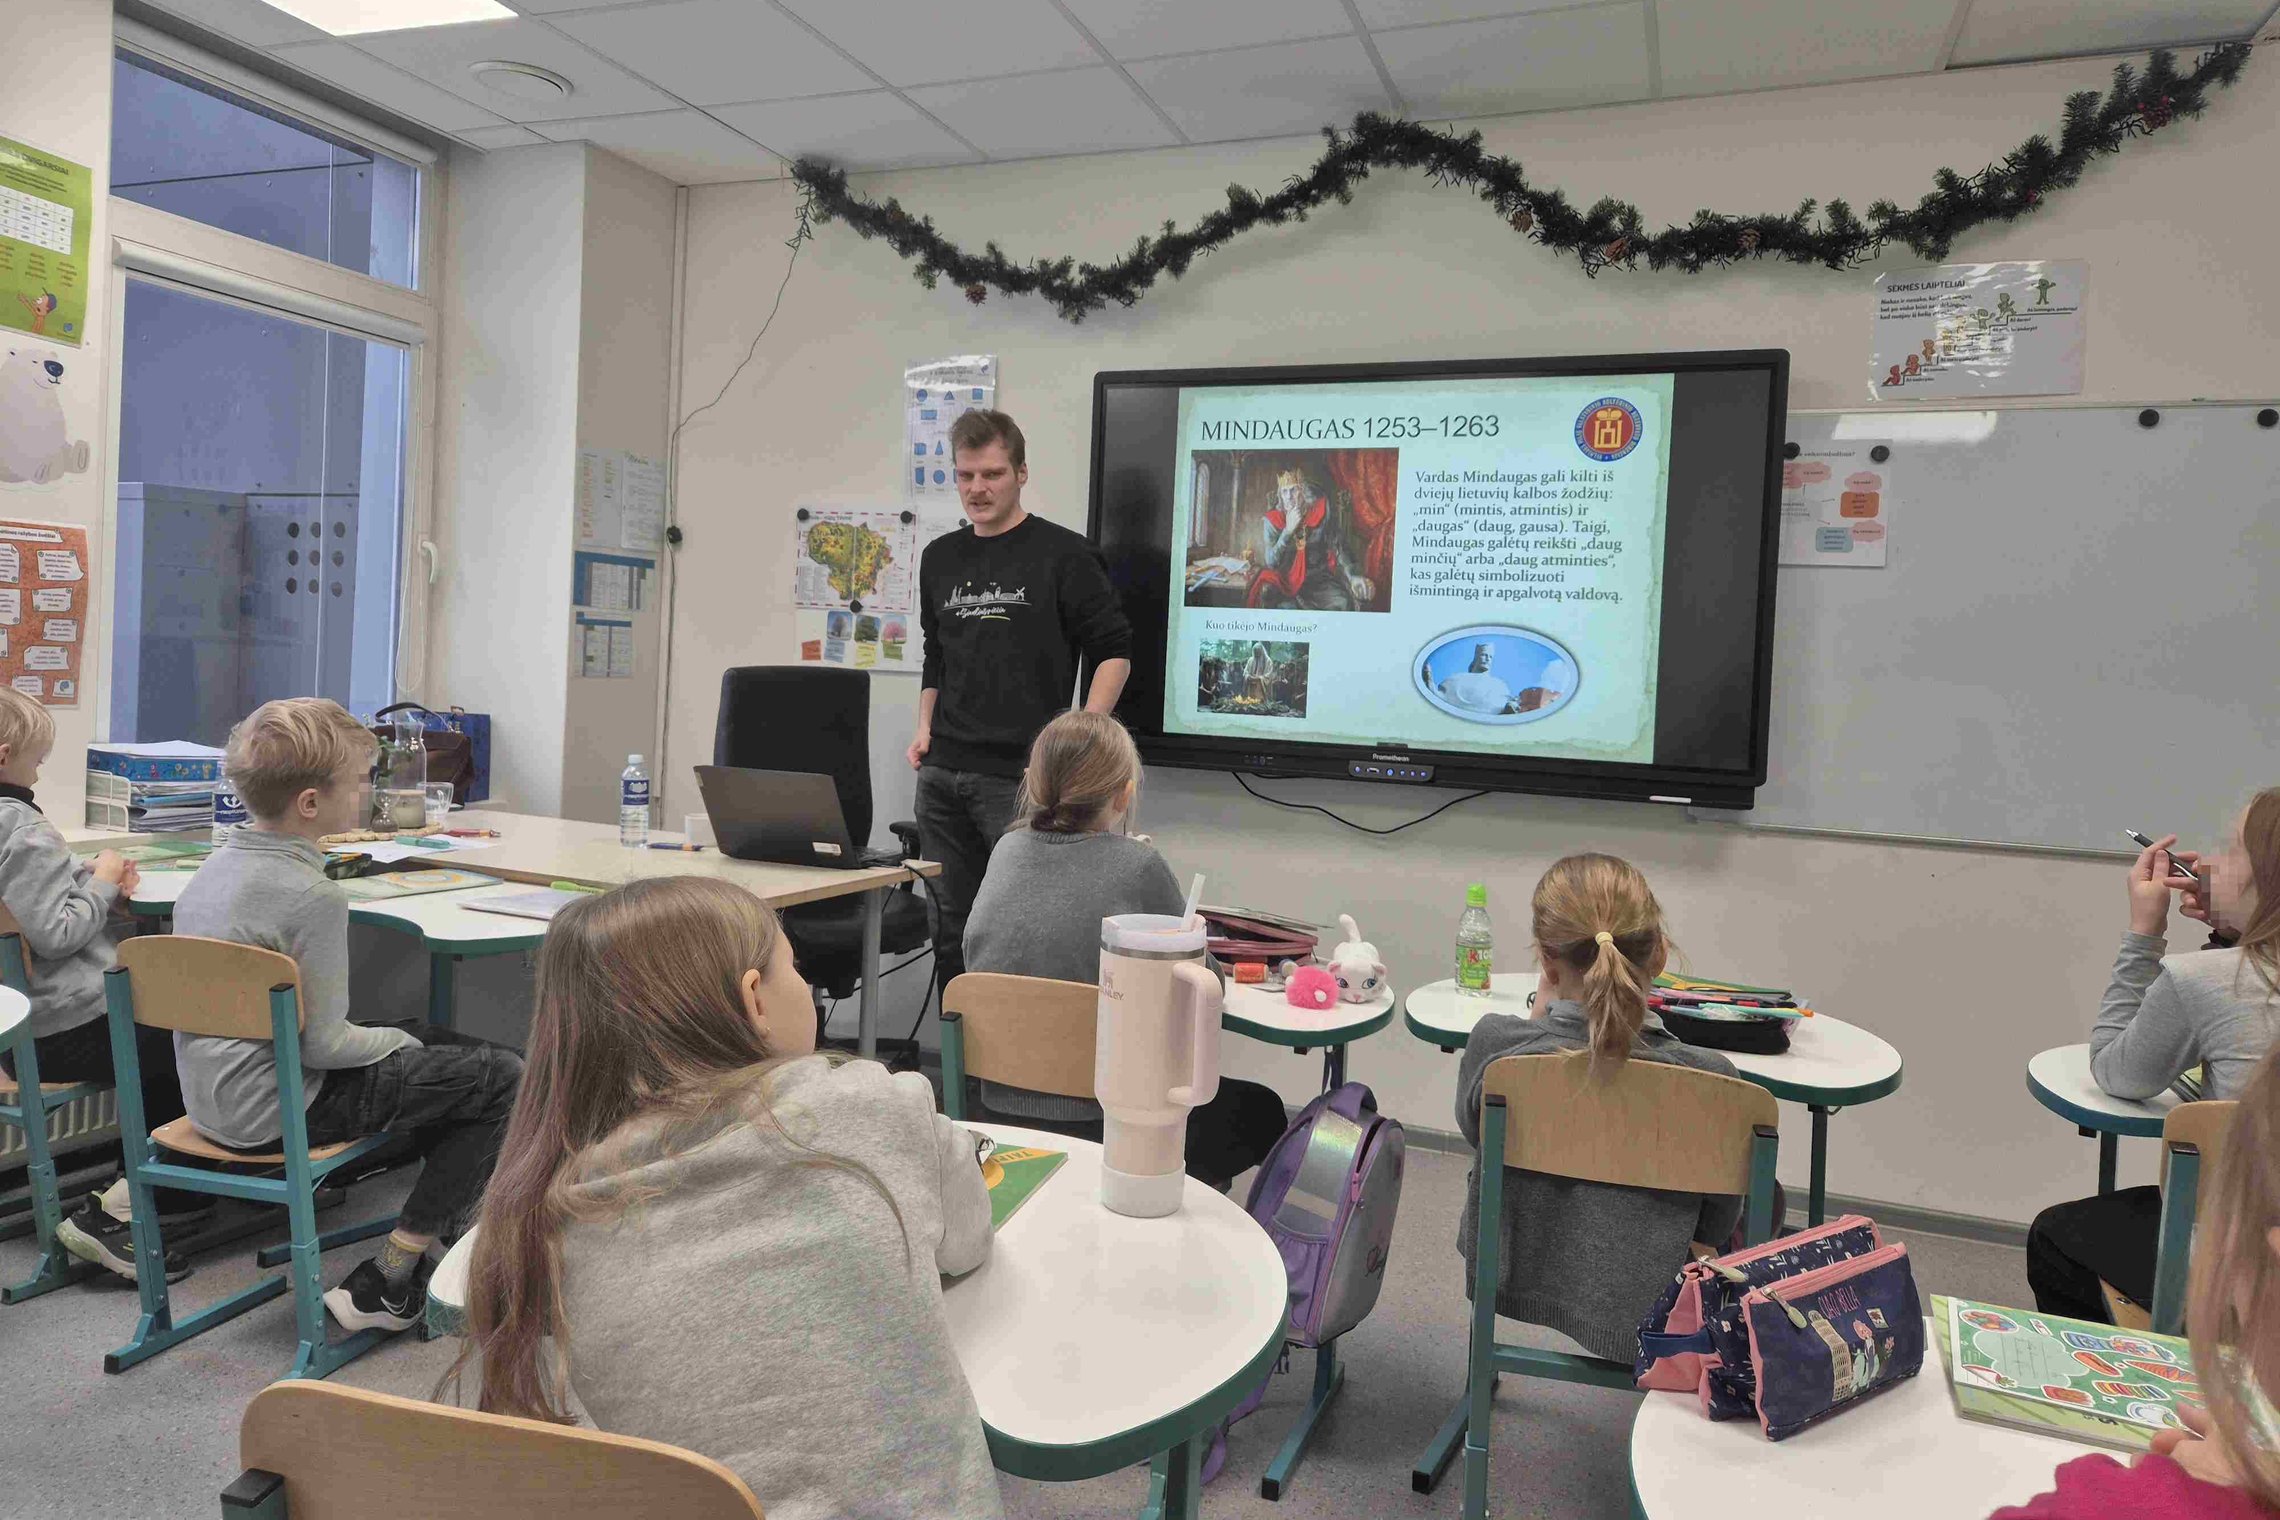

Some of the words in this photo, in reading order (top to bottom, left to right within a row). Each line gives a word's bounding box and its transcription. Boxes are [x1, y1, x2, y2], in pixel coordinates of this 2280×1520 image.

[1201, 419, 1355, 441] MINDAUGAS
[1363, 415, 1500, 438] 1253–1263
[1416, 471, 1459, 483] Vardas
[1463, 471, 1537, 486] Mindaugas
[1541, 470, 1565, 486] gali
[1570, 470, 1598, 482] kilti
[1603, 470, 1614, 481] iš
[1415, 487, 1453, 501] dviejų
[1458, 487, 1509, 502] lietuvių
[1513, 487, 1557, 499] kalbos
[1561, 487, 1612, 502] žodžių:
[1454, 504, 1506, 517] (mintis,
[1510, 504, 1573, 517] atmintis)
[1578, 505, 1588, 516] ir
[1474, 520, 1515, 534] (daug,
[1520, 520, 1567, 534] gausa).
[1573, 520, 1610, 535] Taigi,
[1412, 536, 1484, 551] Mindaugas
[1488, 536, 1529, 551] galėtų
[1534, 537, 1576, 549] reikšti
[1466, 553, 1494, 564] arba
[1410, 568, 1430, 579] kas
[1434, 569, 1474, 583] galėtų
[1478, 570, 1564, 582] simbolizuoti
[1410, 584, 1478, 599] išmintingą
[1484, 585, 1493, 597] ir
[1496, 586, 1562, 602] apgalvotą
[1566, 587, 1623, 603] valdovą.
[1206, 620, 1225, 630] Kuo
[1258, 622, 1317, 634] Mindaugas?
